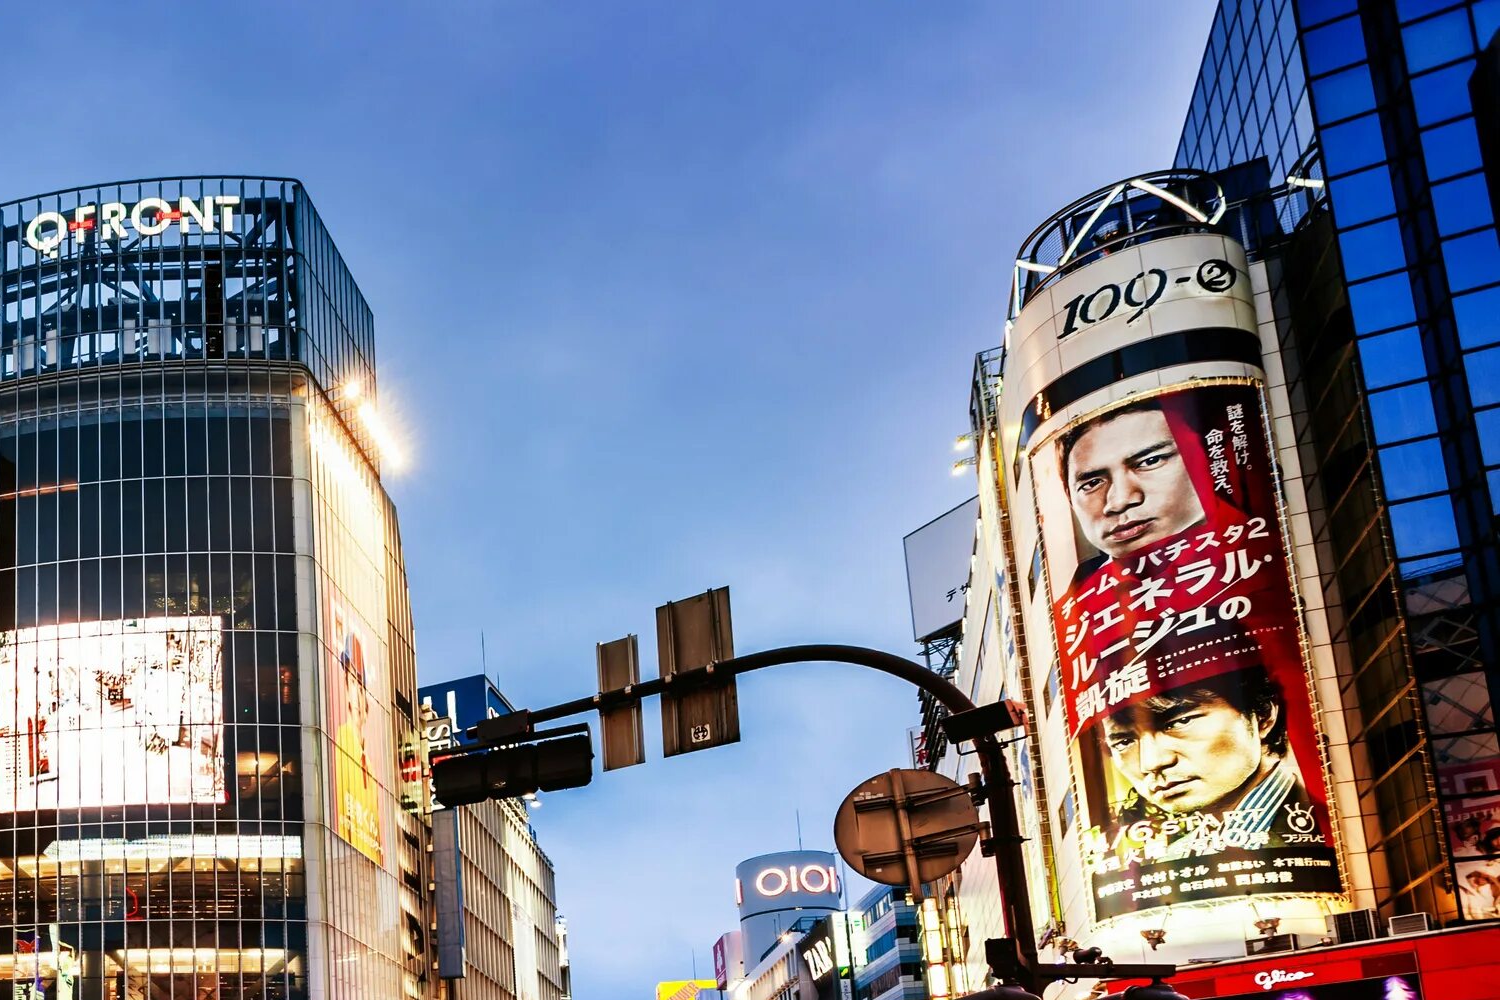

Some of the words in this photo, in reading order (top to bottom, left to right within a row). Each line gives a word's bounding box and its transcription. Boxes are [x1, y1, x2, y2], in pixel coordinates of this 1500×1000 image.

[26, 195, 240, 259] QFRONT
[1204, 428, 1234, 495] 命を救え。
[1156, 633, 1238, 664] TRIUMPHANT
[1157, 661, 1174, 671] OF
[1157, 656, 1219, 679] GENERAL
[1075, 659, 1151, 726] 凱旋
[1281, 833, 1327, 844] フジテレビ
